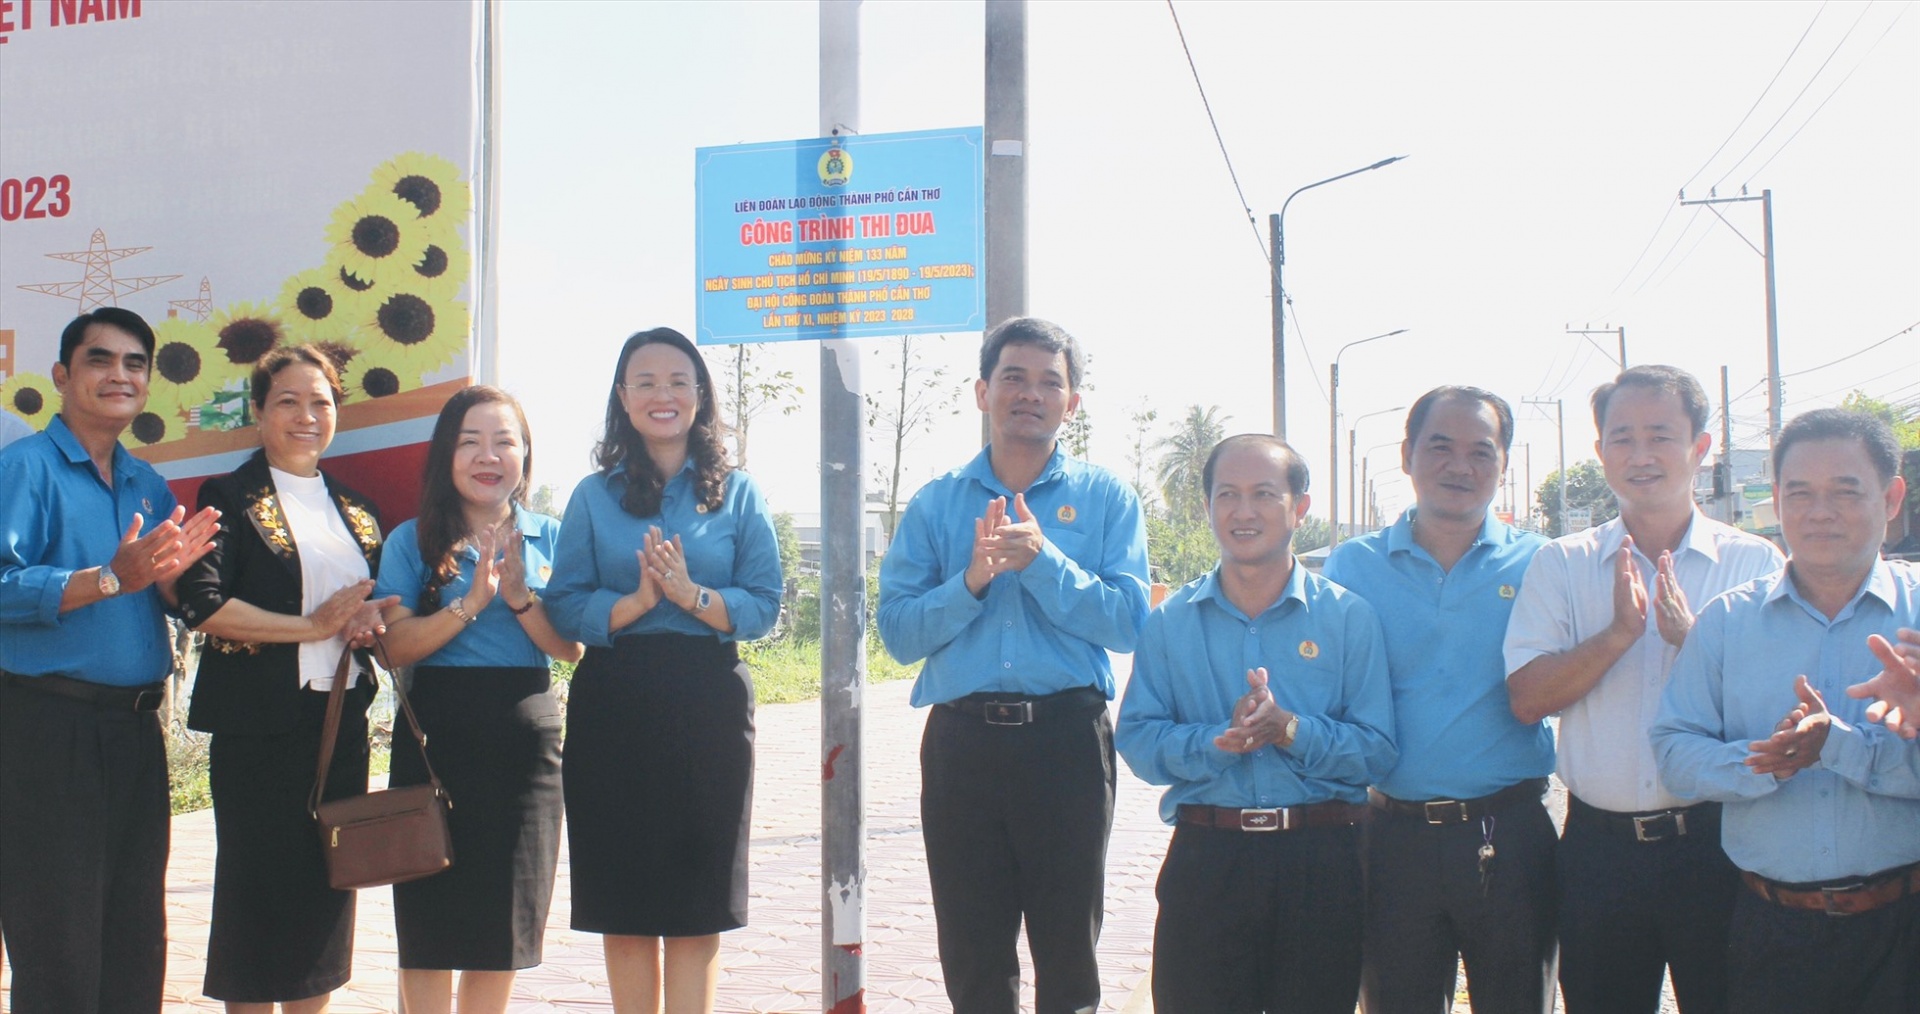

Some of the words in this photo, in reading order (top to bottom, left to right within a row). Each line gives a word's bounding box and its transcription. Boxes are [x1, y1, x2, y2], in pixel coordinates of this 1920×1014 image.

[735, 199, 756, 213] LIÊN
[759, 197, 785, 211] ĐOÀN
[788, 197, 806, 210] LAO
[809, 194, 836, 210] ĐỘNG
[839, 192, 871, 206] THÀNH
[874, 189, 894, 204] PHỐ
[897, 187, 918, 202] CẦN
[921, 187, 941, 200] THƠ
[740, 218, 792, 245] CÔNG
[798, 213, 854, 242] TRÌNH
[860, 214, 890, 238] THI
[896, 212, 935, 236] ĐUA
[768, 251, 793, 267] CHÀO
[796, 250, 823, 265] MỪNG
[825, 248, 837, 264] KỶ
[838, 248, 863, 264] NIỆM
[866, 248, 882, 261] 133
[884, 246, 907, 260] NĂM
[704, 276, 730, 292] NGÀY
[732, 277, 753, 290] SINH
[756, 272, 774, 288] CHỦ
[776, 274, 796, 290] TỊCH
[813, 271, 828, 285] CHÍ
[831, 270, 855, 284] MINH
[858, 267, 909, 284] (19/5/1890
[919, 264, 975, 279] 19/5/2023);
[746, 296, 763, 312] ĐẠI
[764, 293, 780, 311] HỘI
[782, 293, 807, 307] CÔNG
[810, 290, 835, 306] ĐOÀN
[837, 288, 867, 304] THÀNH
[869, 284, 889, 302] PHỐ
[890, 284, 910, 301] CẦN
[912, 285, 932, 300] THƠ
[762, 312, 781, 328] LẦN
[784, 312, 801, 327] THỨ
[802, 314, 815, 327] XI,
[817, 311, 847, 326] NHIỆM
[863, 310, 886, 323] 2023
[891, 308, 914, 322] 2028
